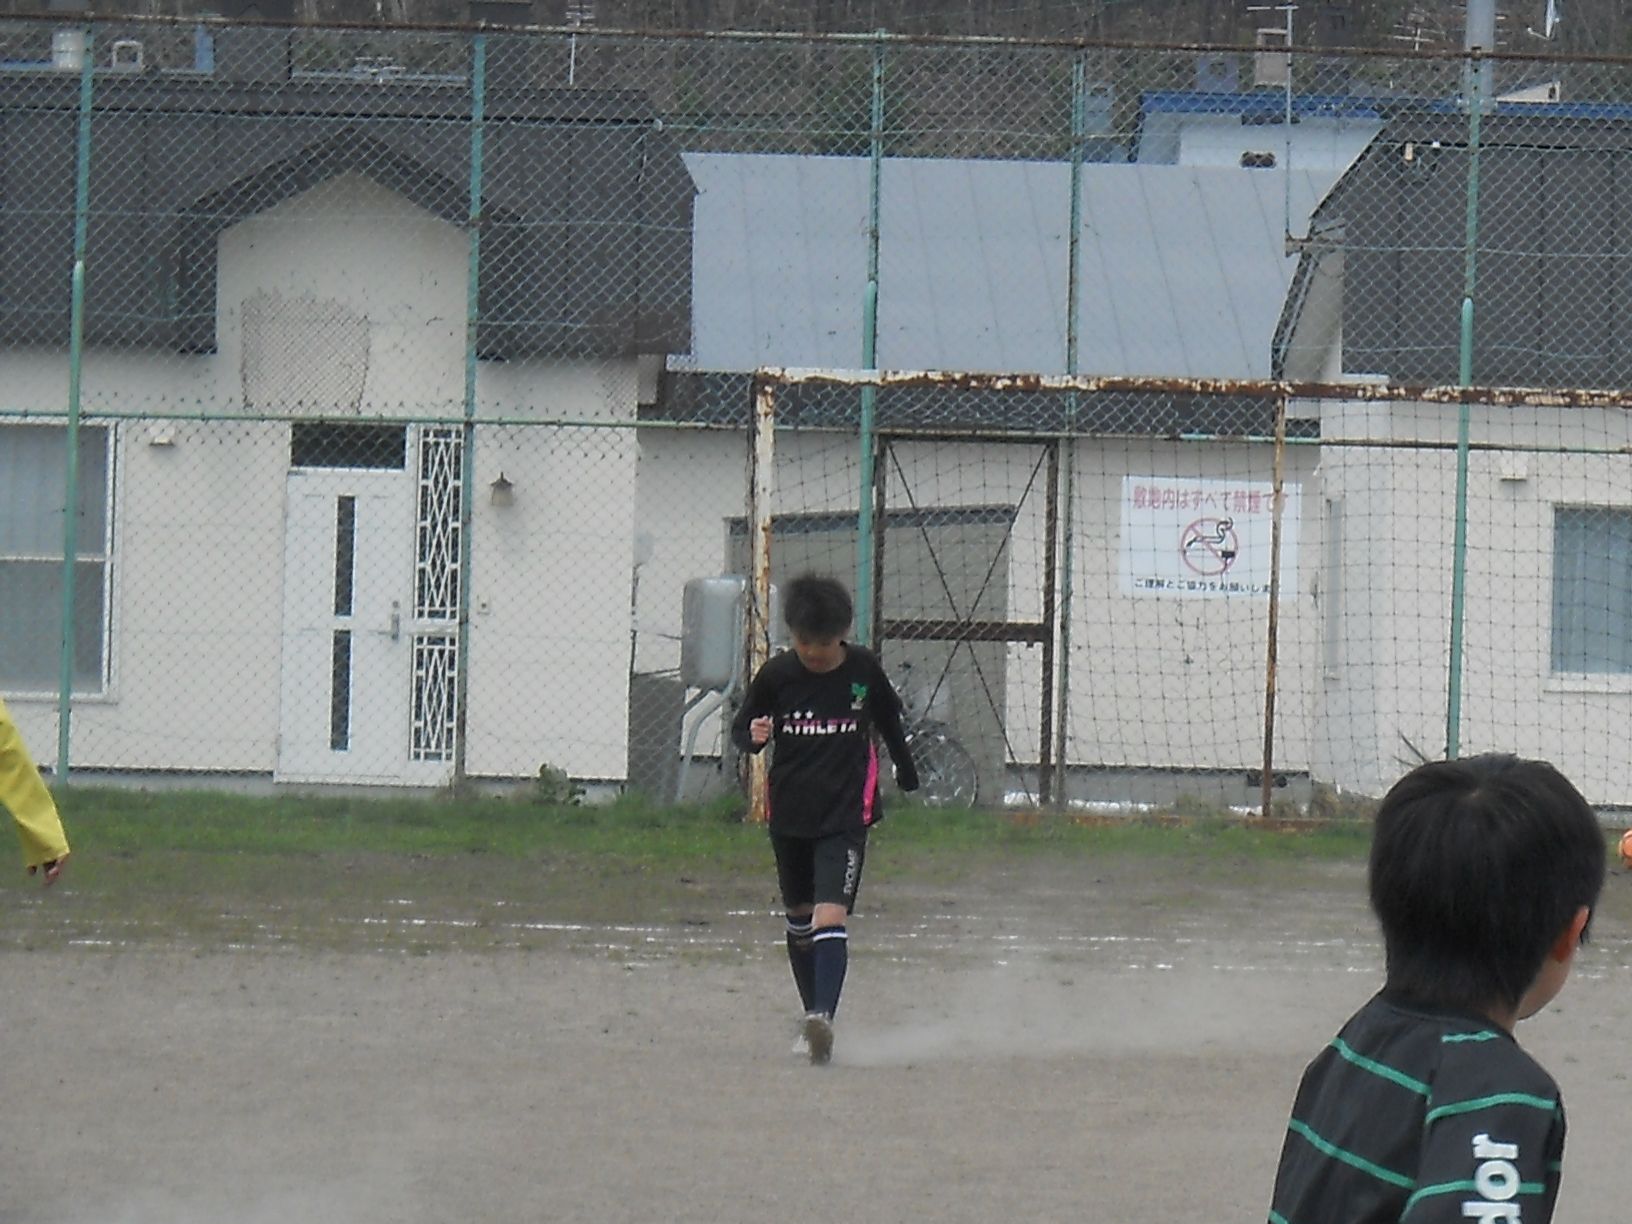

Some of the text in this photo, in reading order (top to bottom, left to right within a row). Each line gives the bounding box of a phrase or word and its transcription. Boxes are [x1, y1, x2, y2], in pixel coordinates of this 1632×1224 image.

[1134, 577, 1273, 594] ご理解とご協力をお願いしま
[782, 718, 858, 735] ATHLETA
